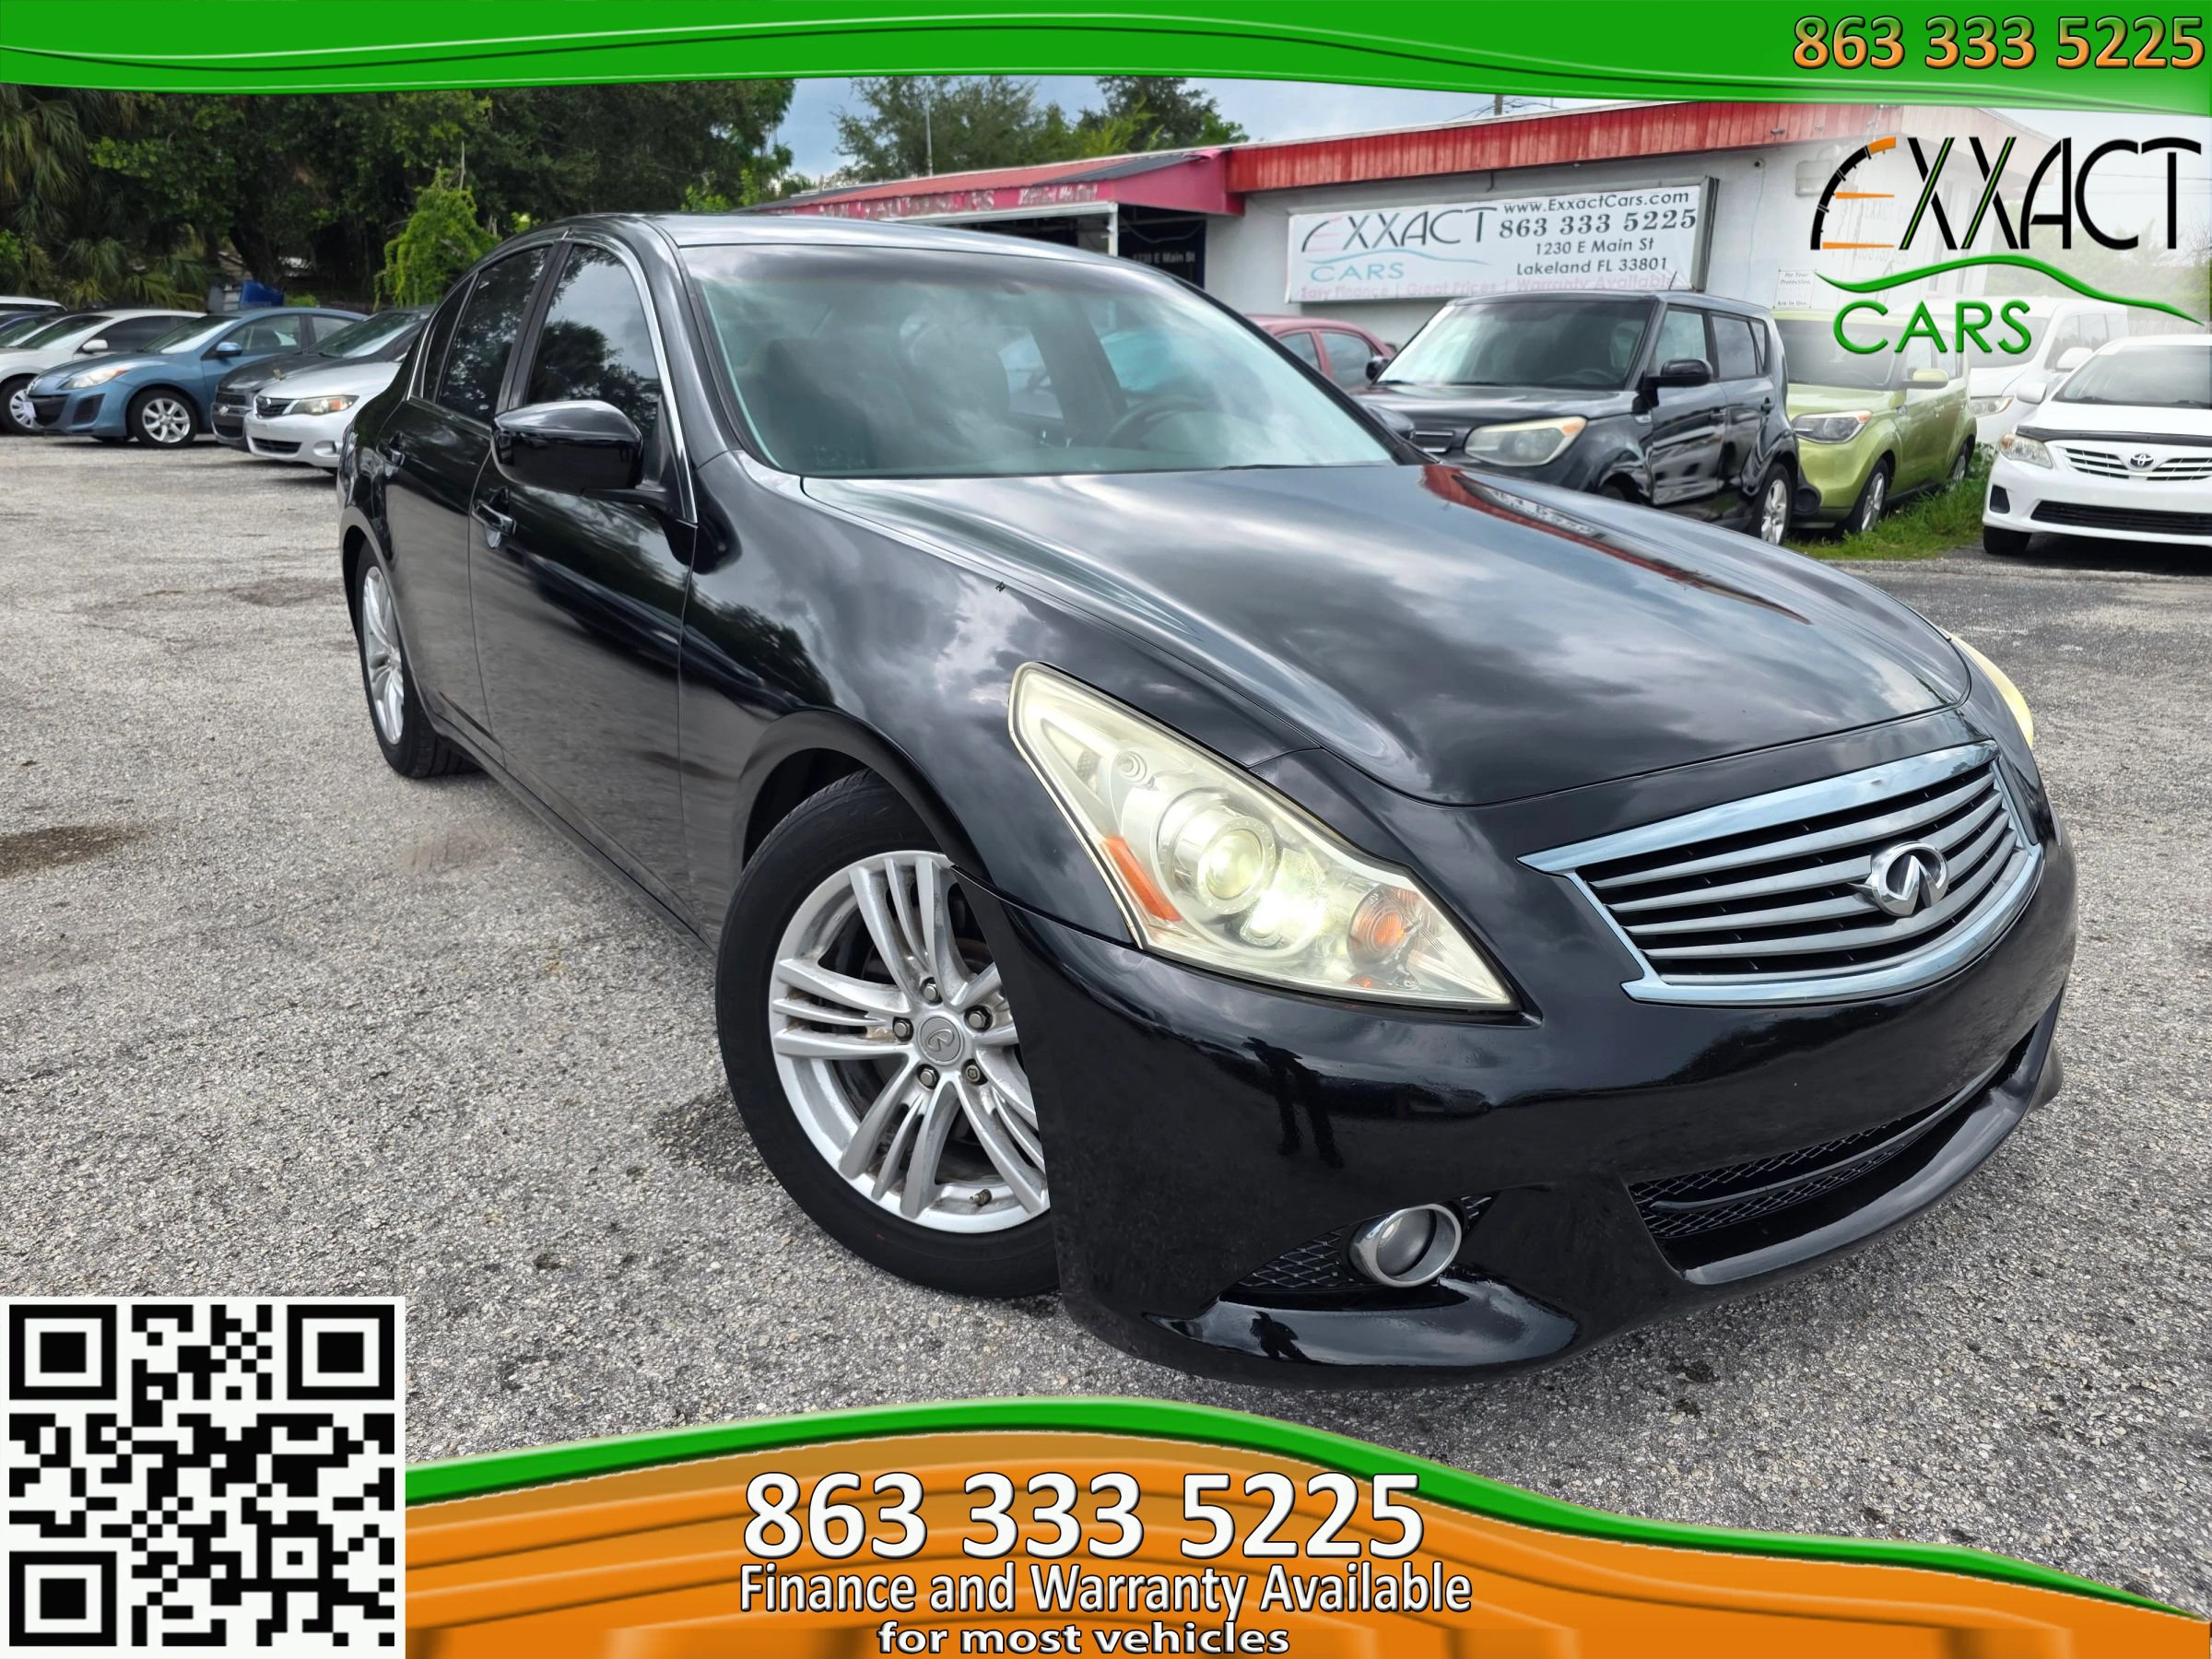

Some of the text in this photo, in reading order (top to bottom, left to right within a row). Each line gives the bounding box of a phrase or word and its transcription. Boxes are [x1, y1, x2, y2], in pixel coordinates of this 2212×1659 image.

[1503, 192, 1688, 214] www.ExxactCars.com
[1301, 206, 1498, 253] EXXACT
[1499, 208, 1696, 239] 863 333 5225
[1535, 237, 1654, 255] 1230 E Main St
[1310, 262, 1405, 283] CARS
[1516, 257, 1667, 276] Lakeland FL 33801
[1335, 284, 1388, 298] Finance
[1406, 282, 1446, 296] Great
[1453, 280, 1497, 296] Prices
[1517, 276, 1588, 291] Warranty
